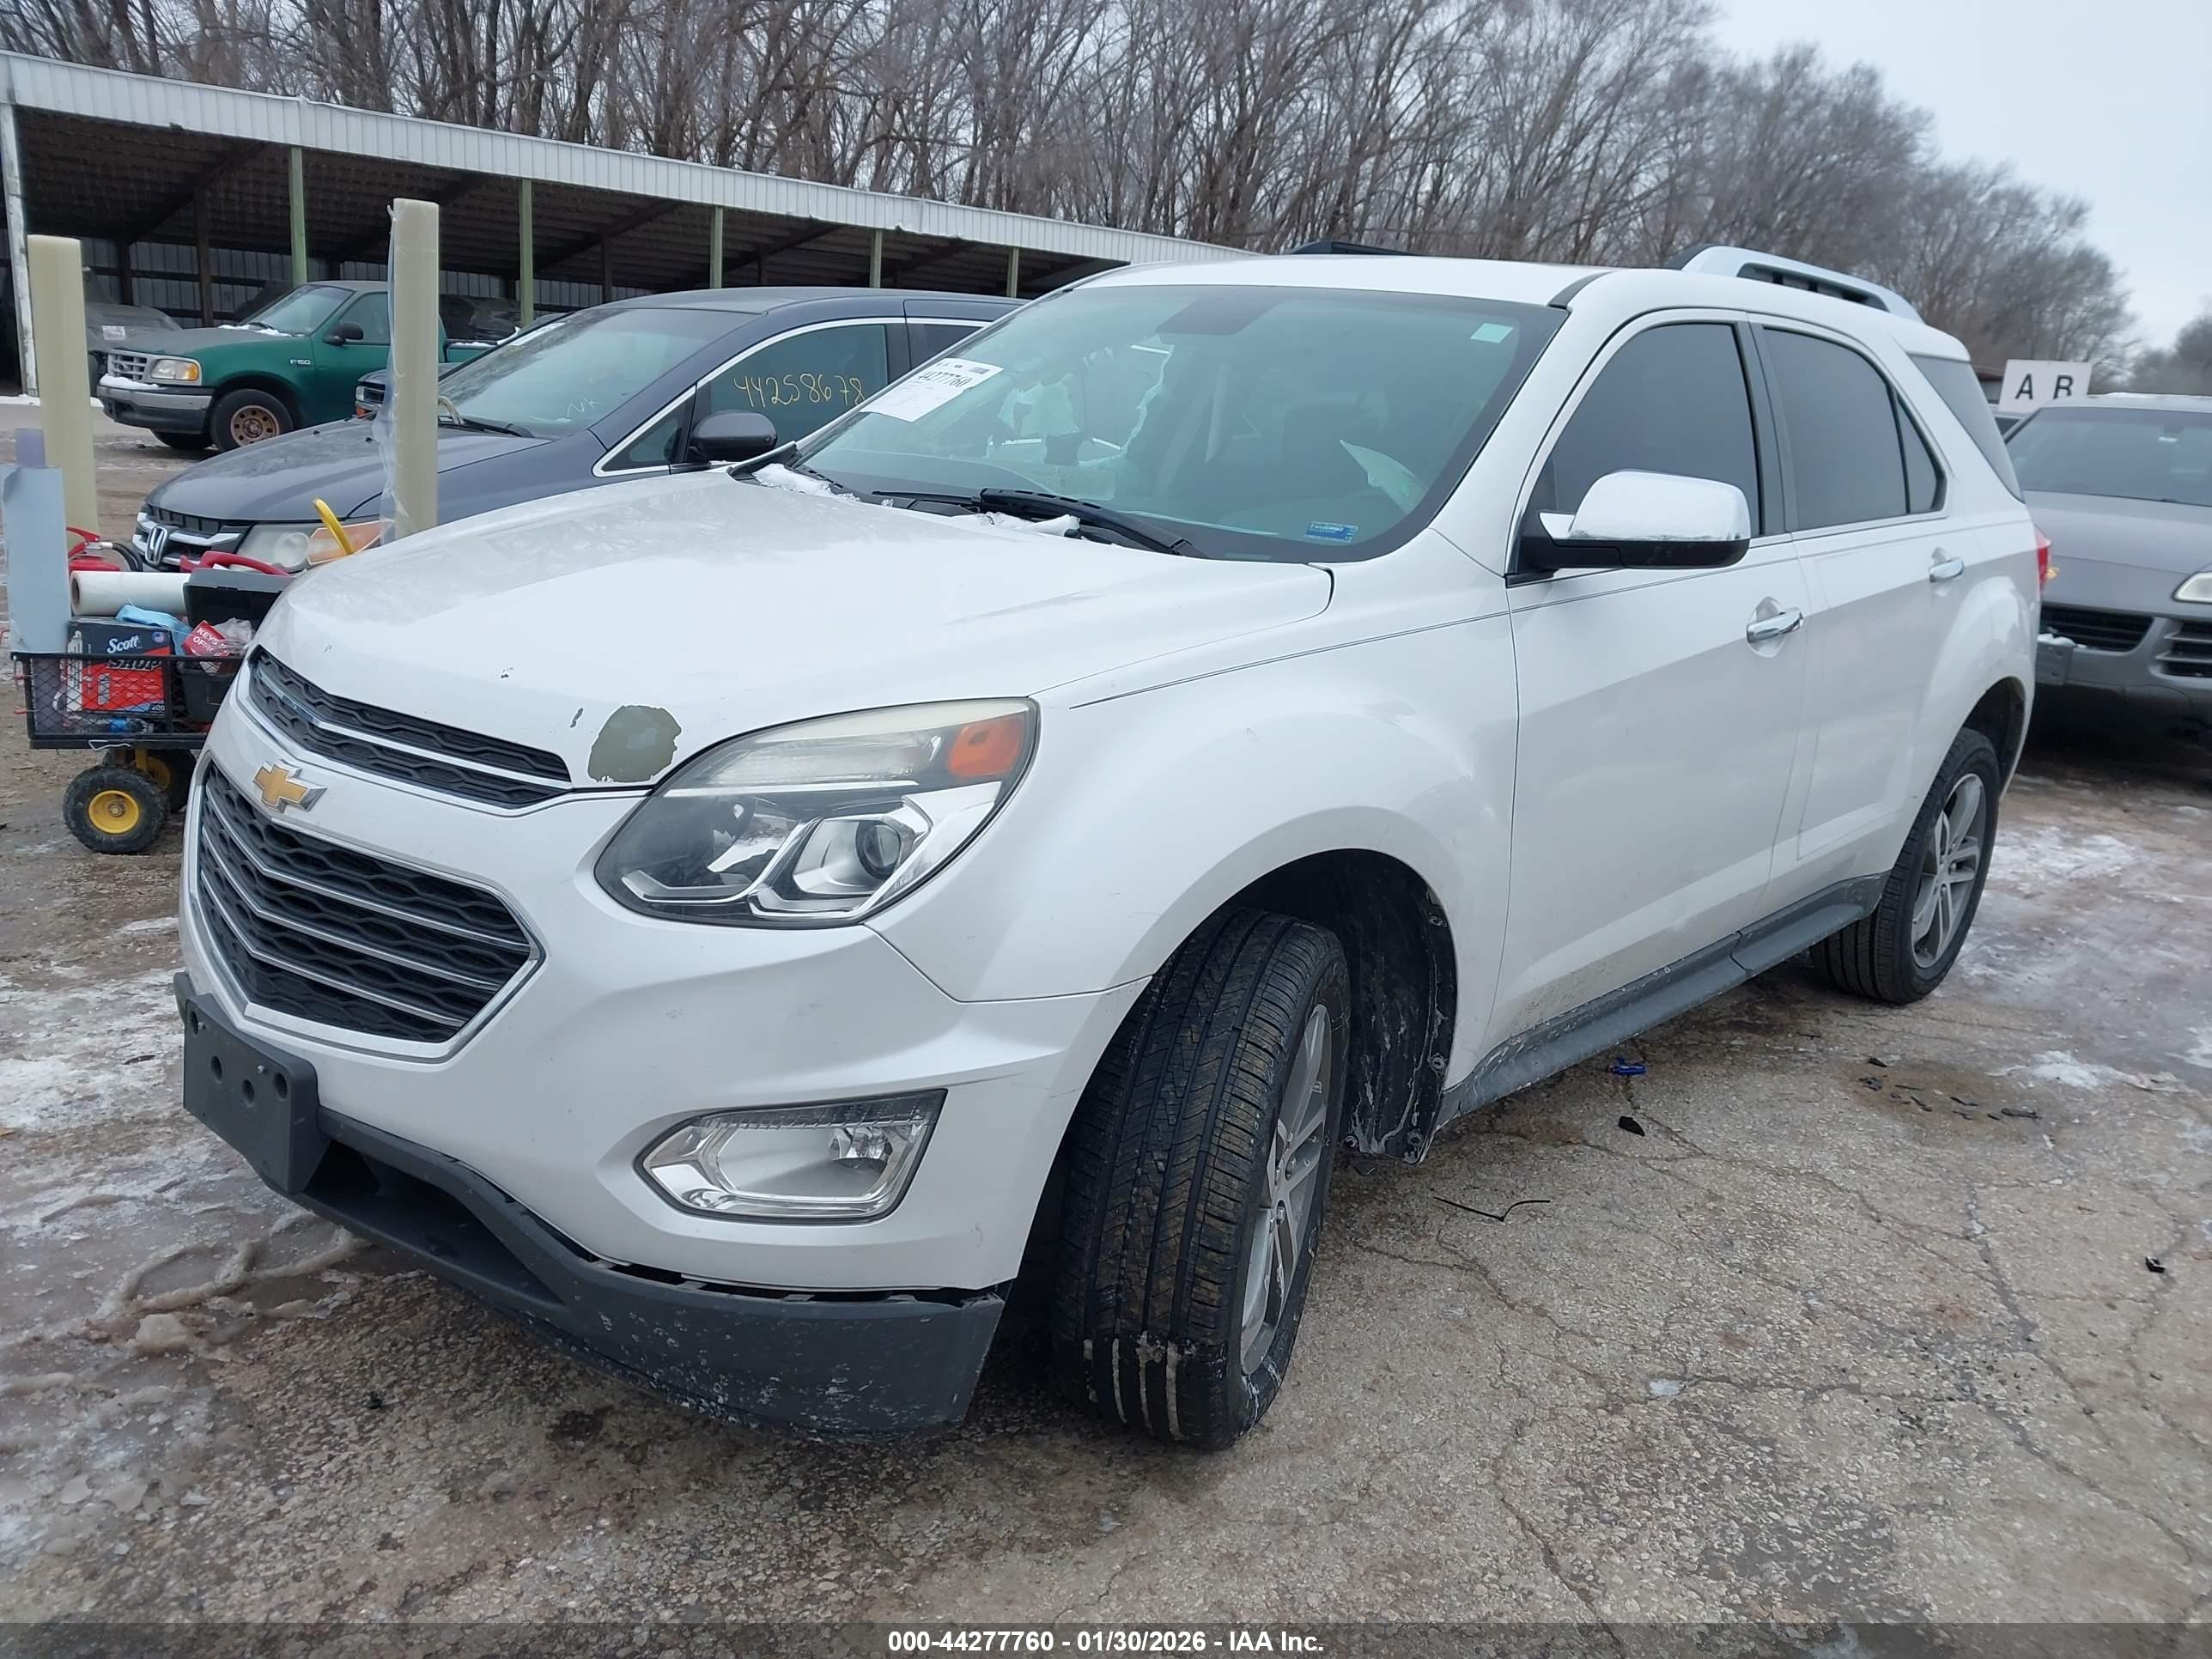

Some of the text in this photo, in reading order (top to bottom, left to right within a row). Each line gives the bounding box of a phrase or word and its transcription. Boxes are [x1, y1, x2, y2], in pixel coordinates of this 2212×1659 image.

[733, 373, 866, 408] 44258678
[2014, 373, 2033, 400] A
[106, 635, 140, 653] Scott
[197, 627, 220, 646] KEYS
